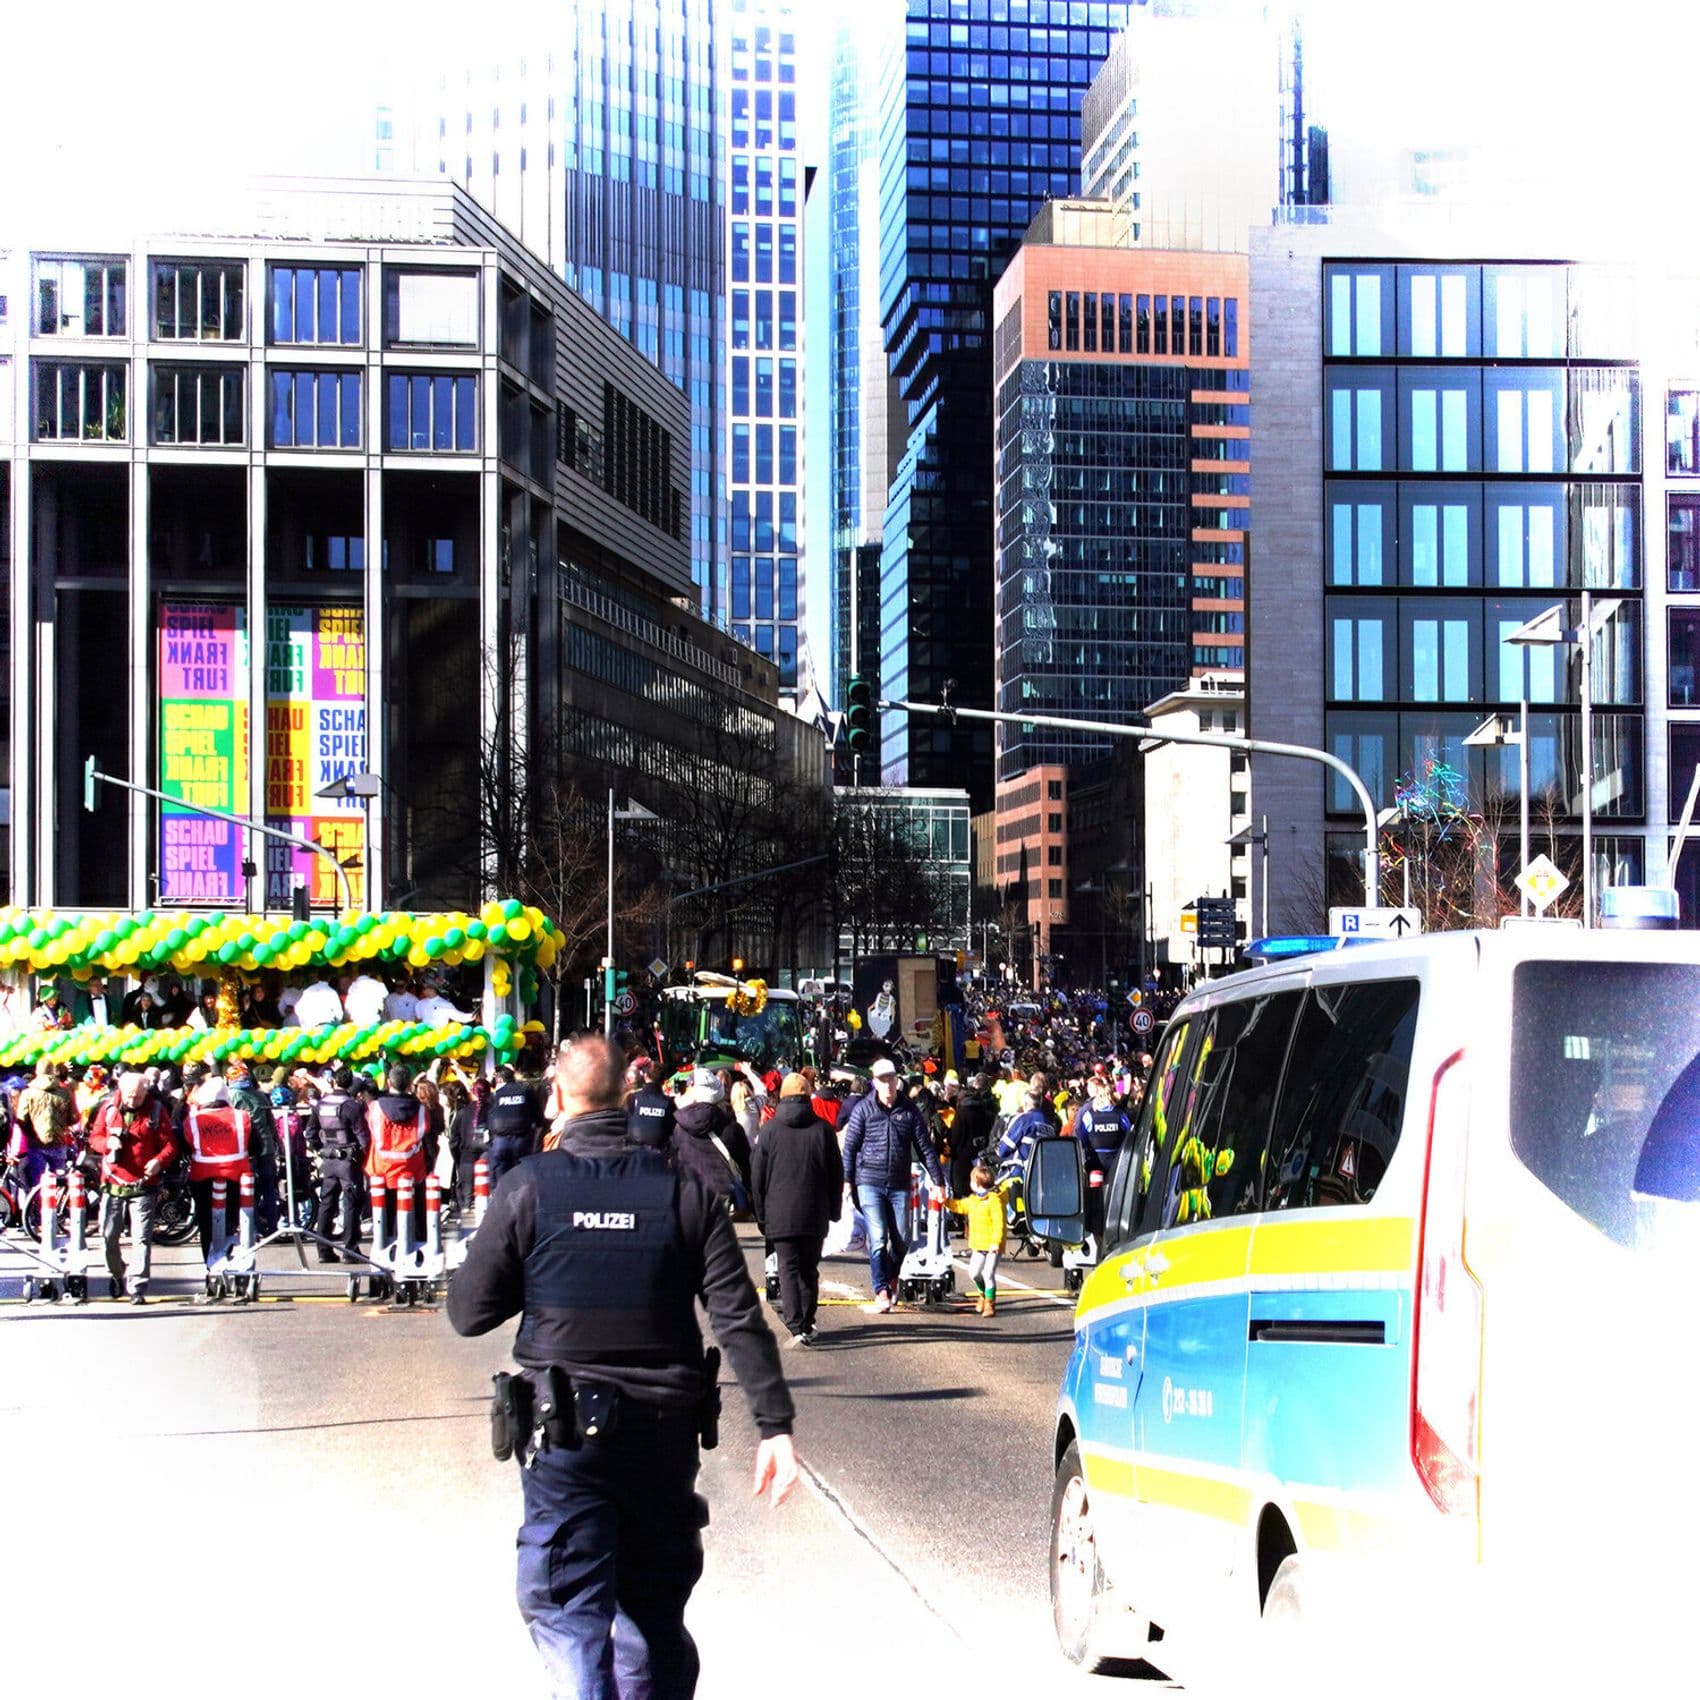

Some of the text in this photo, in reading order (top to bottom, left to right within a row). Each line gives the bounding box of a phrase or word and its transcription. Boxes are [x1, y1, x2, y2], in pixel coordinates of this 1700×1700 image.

[167, 616, 216, 639] SPIEL
[319, 708, 365, 731] SCHA
[166, 820, 228, 846] SCHAU
[166, 846, 217, 871] SPIEL
[1135, 1015, 1148, 1026] 40
[639, 1106, 665, 1117] POLIZEI
[1094, 1123, 1118, 1132] POLIZEI
[573, 1211, 635, 1229] POLIZEI
